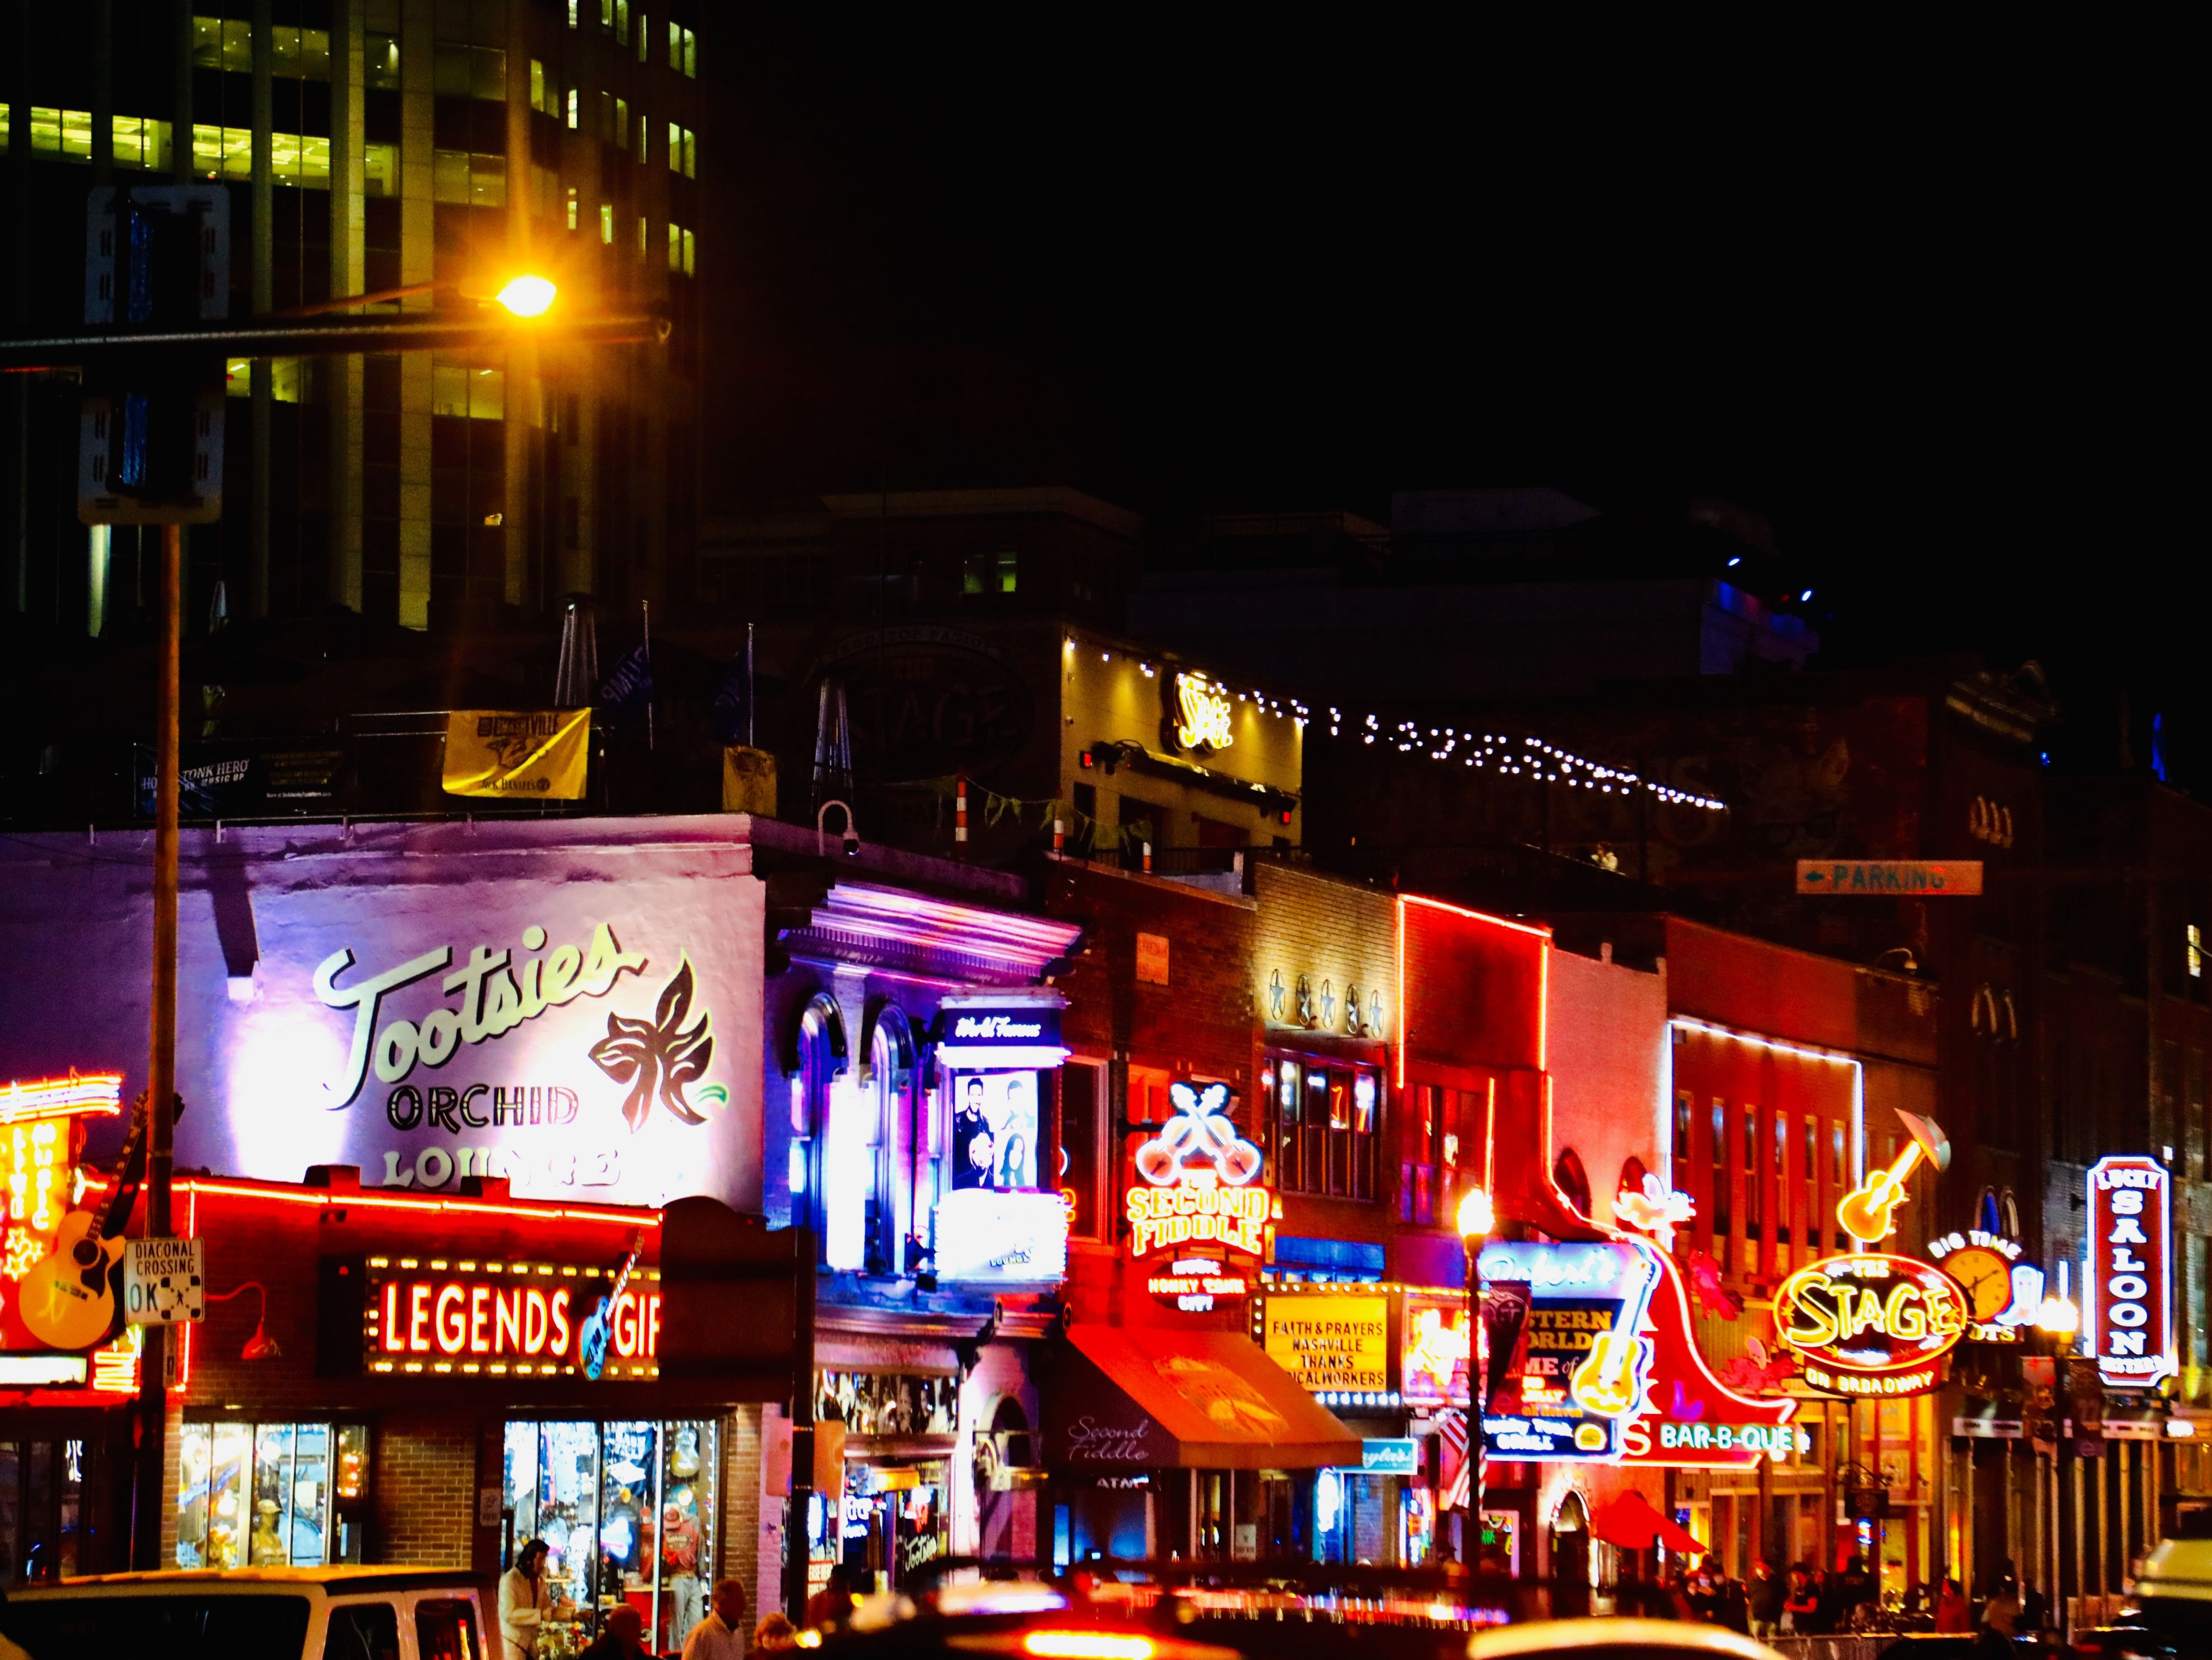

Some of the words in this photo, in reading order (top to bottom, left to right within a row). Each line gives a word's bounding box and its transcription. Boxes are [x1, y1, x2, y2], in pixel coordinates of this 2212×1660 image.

[216, 759, 249, 776] HERO
[1834, 865, 1945, 890] PARKING
[313, 923, 648, 1111] Tootsies
[387, 1084, 579, 1135] ORCHID
[1126, 1187, 1270, 1223] SECOND
[1133, 1215, 1262, 1257] FIDDLE
[1928, 1232, 1966, 1258] BIG
[1968, 1230, 2022, 1260] TIME
[136, 1259, 195, 1276] CROSSING
[2108, 1190, 2149, 1355] SALOON
[129, 1283, 159, 1313] OK
[1148, 1278, 1198, 1293] HONKY
[385, 1282, 571, 1356] LEGENDS
[614, 1292, 661, 1358] GIF
[1786, 1271, 1962, 1347] STAGE
[1292, 1338, 1363, 1352] NASHVILLE
[1528, 1331, 1594, 1350] ORLD
[1301, 1355, 1354, 1370] THANKS
[1806, 1367, 1830, 1388] ON
[1838, 1371, 1934, 1394] BROADWAY
[1068, 1416, 1149, 1442] Second
[1660, 1425, 1793, 1451] BAR-B-QUE
[1068, 1438, 1149, 1461] Fiddle
